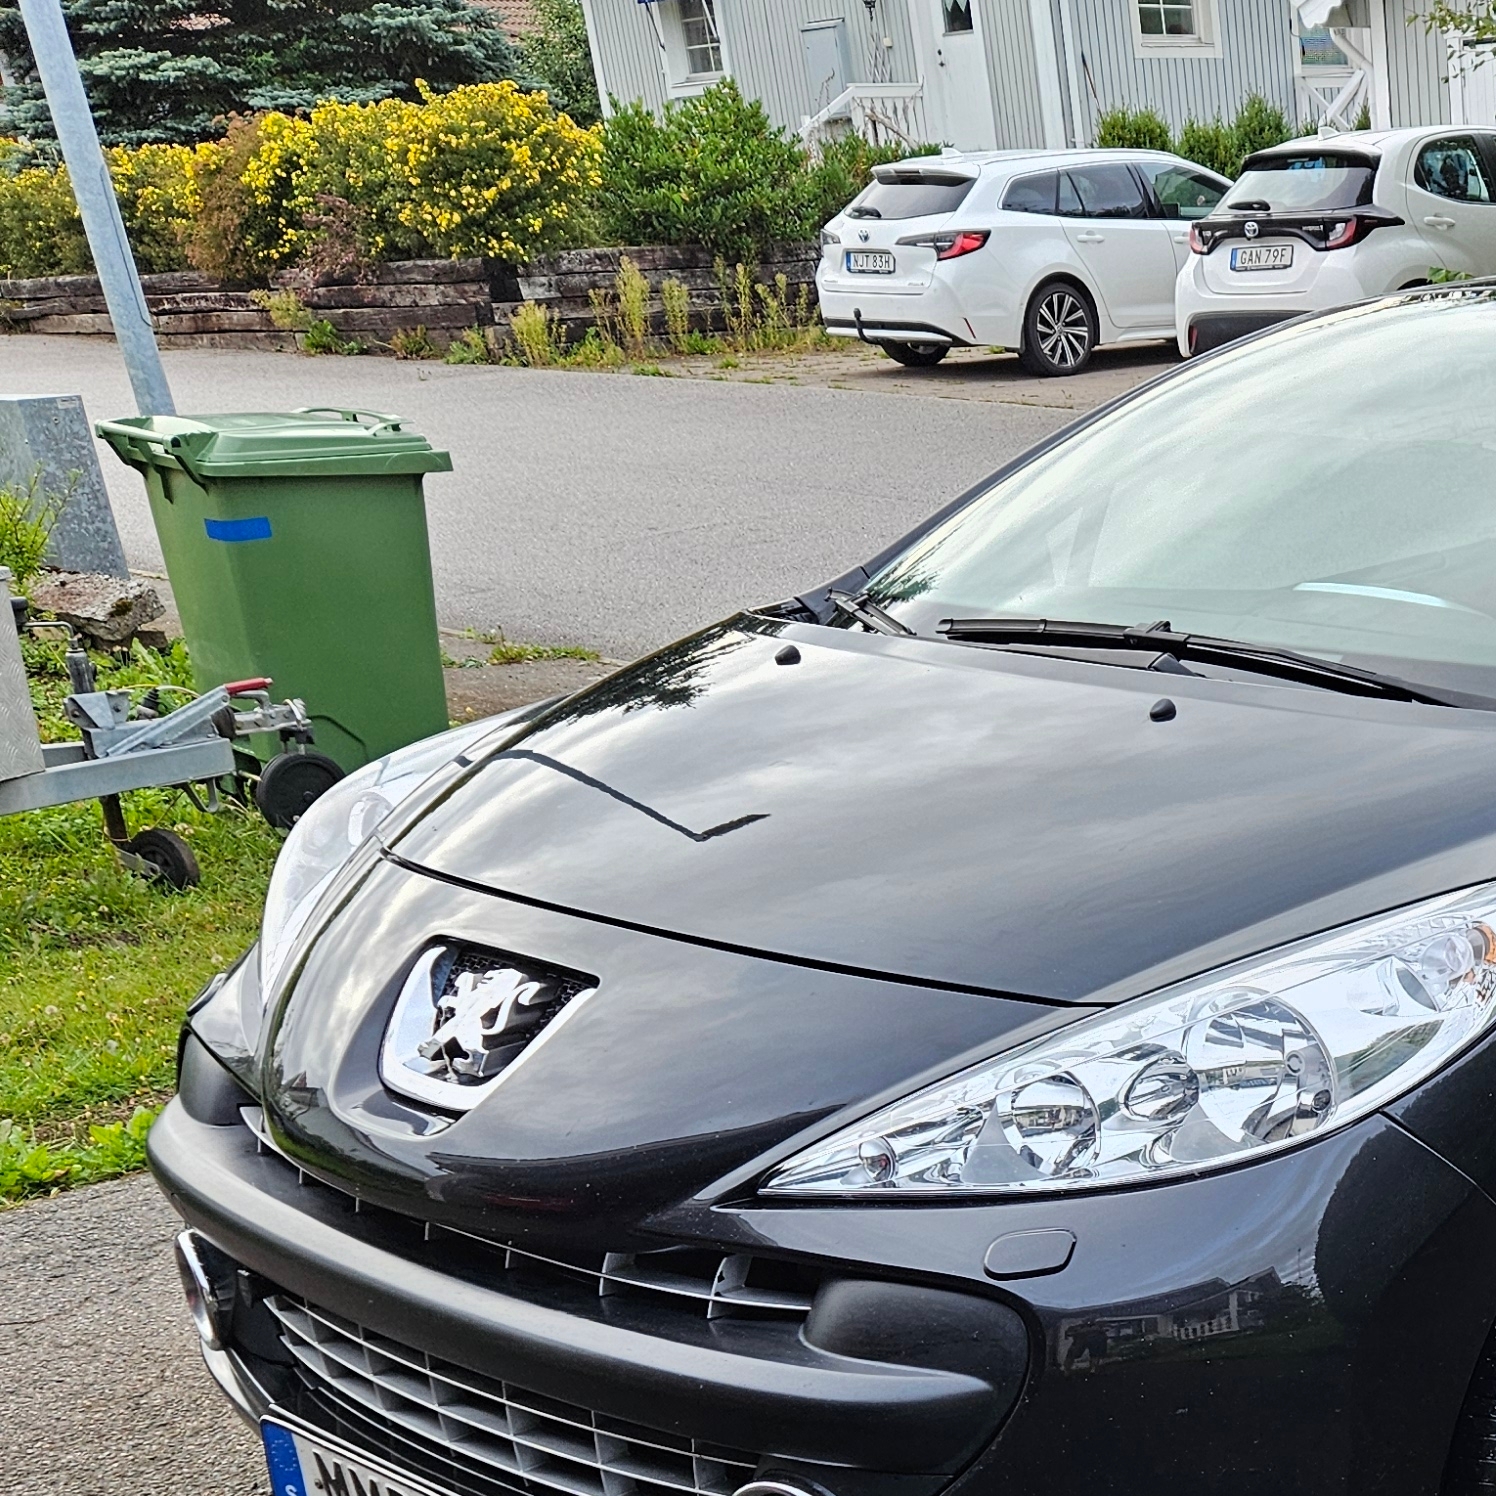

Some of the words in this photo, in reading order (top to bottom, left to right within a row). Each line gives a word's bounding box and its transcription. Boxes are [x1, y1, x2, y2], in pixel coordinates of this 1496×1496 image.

[853, 254, 870, 268] NJT
[872, 254, 890, 268] 83H
[1241, 249, 1262, 265] GAN
[1265, 248, 1287, 263] 79F
